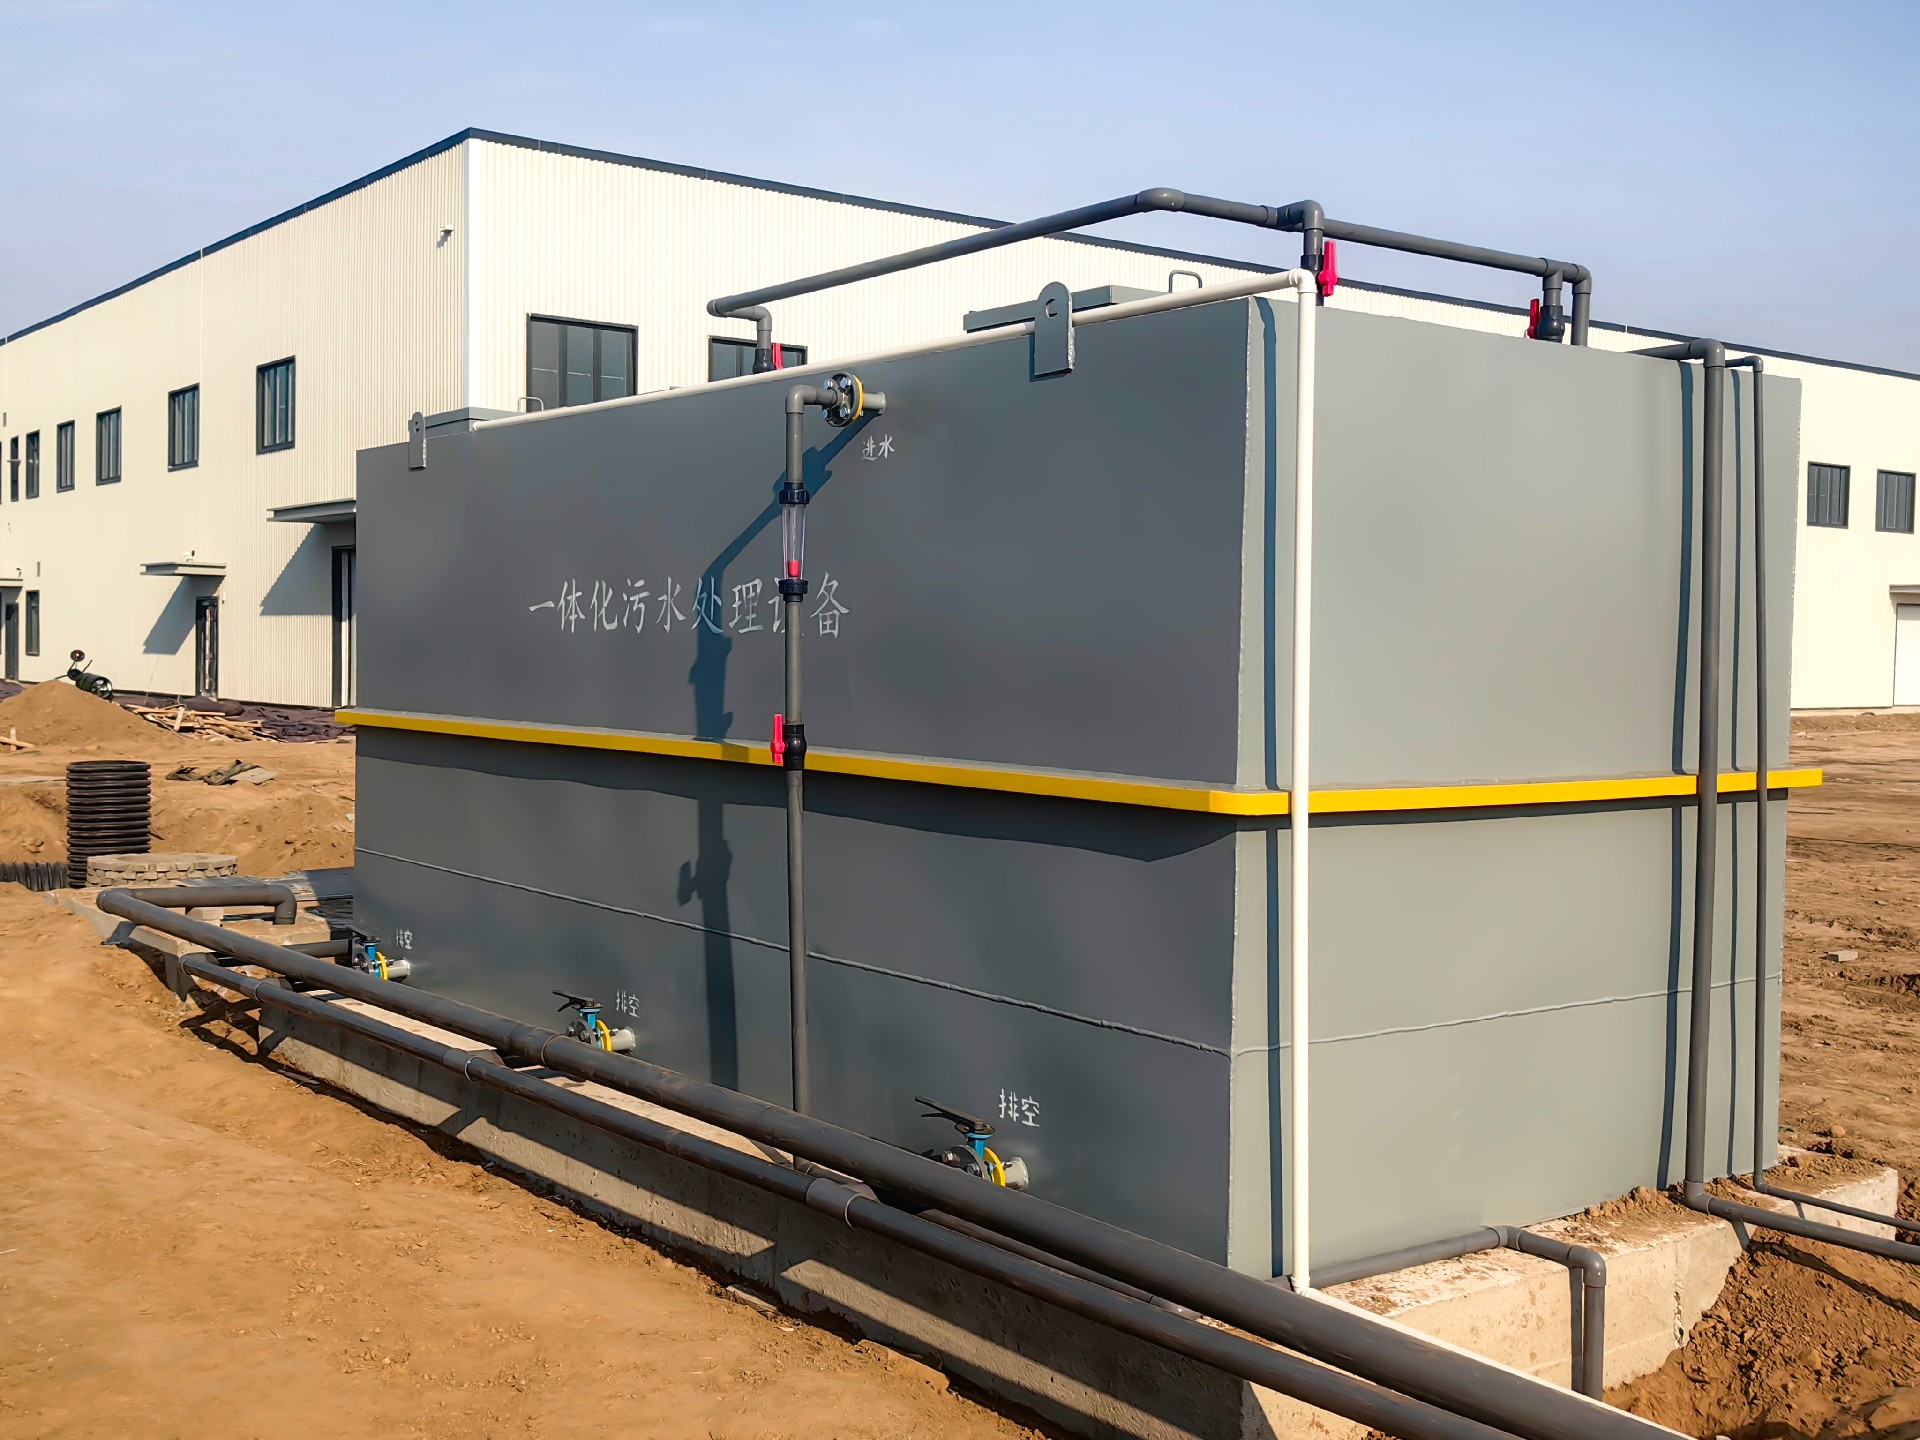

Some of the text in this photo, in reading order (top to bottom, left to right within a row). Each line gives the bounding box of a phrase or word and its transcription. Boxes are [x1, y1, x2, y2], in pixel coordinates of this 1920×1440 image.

[861, 434, 895, 460] 进水
[616, 989, 640, 1018] 排空
[999, 1088, 1040, 1127] 排空
